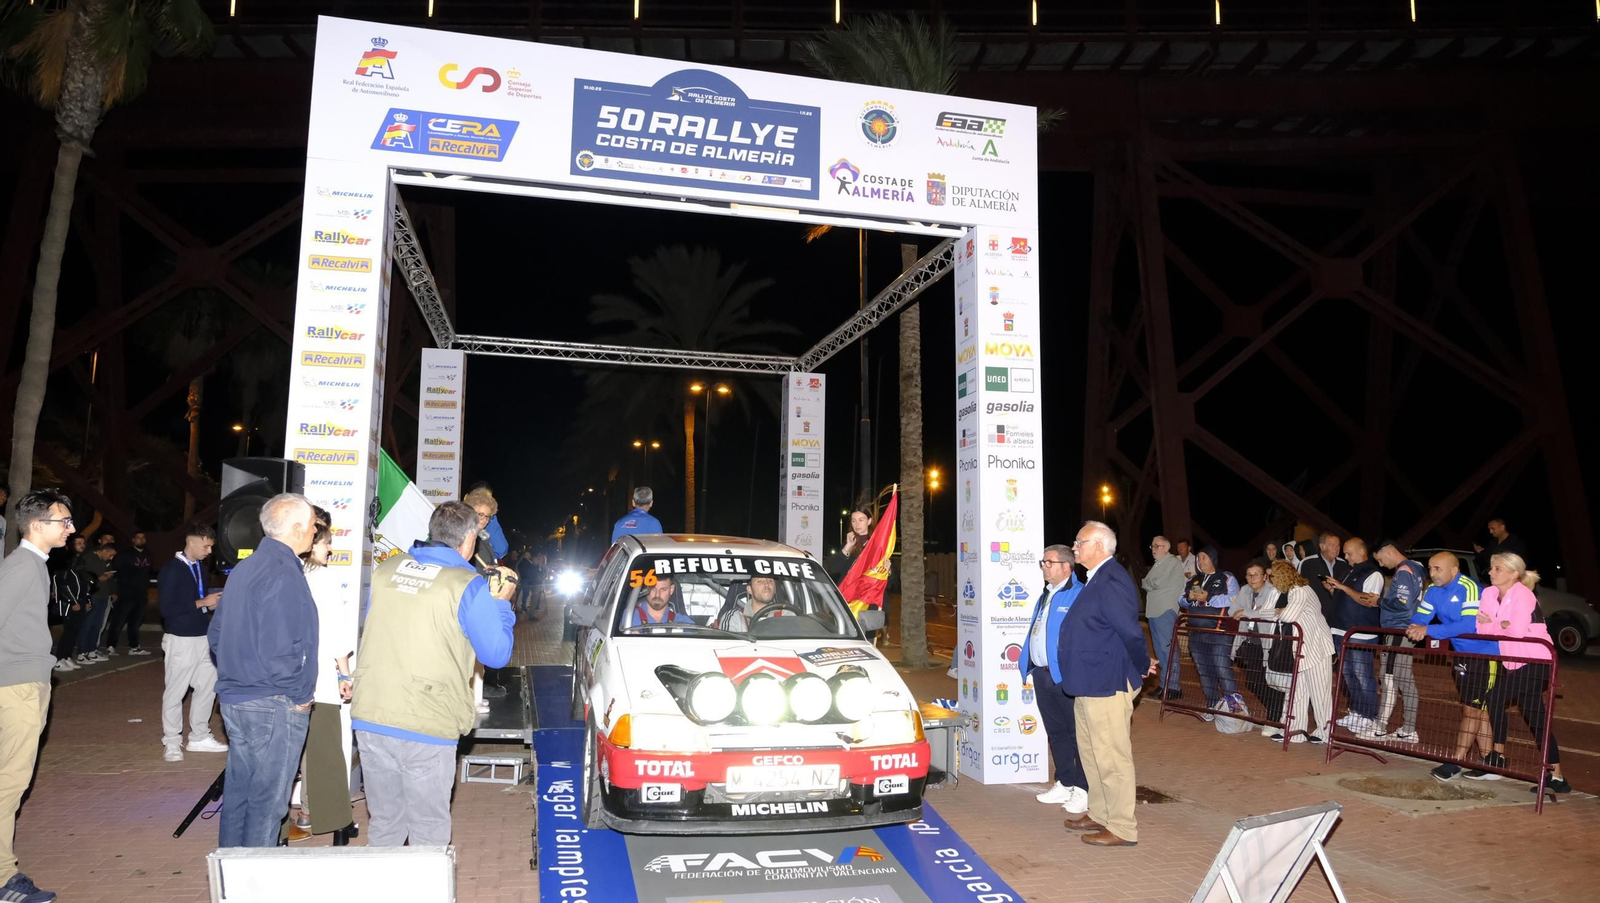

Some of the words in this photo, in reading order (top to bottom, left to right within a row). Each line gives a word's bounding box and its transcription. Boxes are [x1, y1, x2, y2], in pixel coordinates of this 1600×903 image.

[507, 80, 531, 88] Consejo
[688, 92, 712, 100] RALLYE
[428, 118, 500, 137] CERA
[596, 105, 646, 132] 50
[648, 111, 798, 149] RALLYE
[442, 141, 487, 155] Recalvi
[596, 133, 666, 152] COSTA
[670, 142, 698, 156] DE
[702, 144, 795, 166] ALMERÍA
[863, 174, 898, 187] COSTA
[900, 178, 914, 188] DE
[852, 185, 914, 203] ALMERÍA
[952, 185, 1019, 201] DIPUTACIÓN
[952, 197, 967, 207] DE
[969, 199, 1017, 212] ALMERÍA
[321, 258, 360, 270] Recalvi
[985, 342, 1034, 357] MOYA
[314, 355, 353, 365] Recalvi
[959, 402, 976, 422] gasolia
[986, 401, 1034, 414] gasolia
[792, 439, 820, 448] MOYA
[306, 452, 346, 462] Recalvi
[988, 455, 1035, 469] Phonika
[792, 502, 819, 511] Phonika
[654, 558, 748, 574] REFUEL
[754, 559, 816, 580] CAFÉ
[391, 574, 433, 589] FOTO/TV
[629, 569, 658, 588] 56
[634, 759, 695, 777] TOTAL
[752, 755, 804, 766] GEFCO
[871, 753, 918, 770] TOTAL
[992, 753, 1039, 773] argar
[730, 771, 742, 785] M
[754, 770, 801, 788] 4254
[812, 768, 835, 785] NZ
[731, 801, 829, 816] MICHELIN
[674, 870, 742, 880] FEDERACIÓN
[834, 867, 898, 878] VALENCIANA
